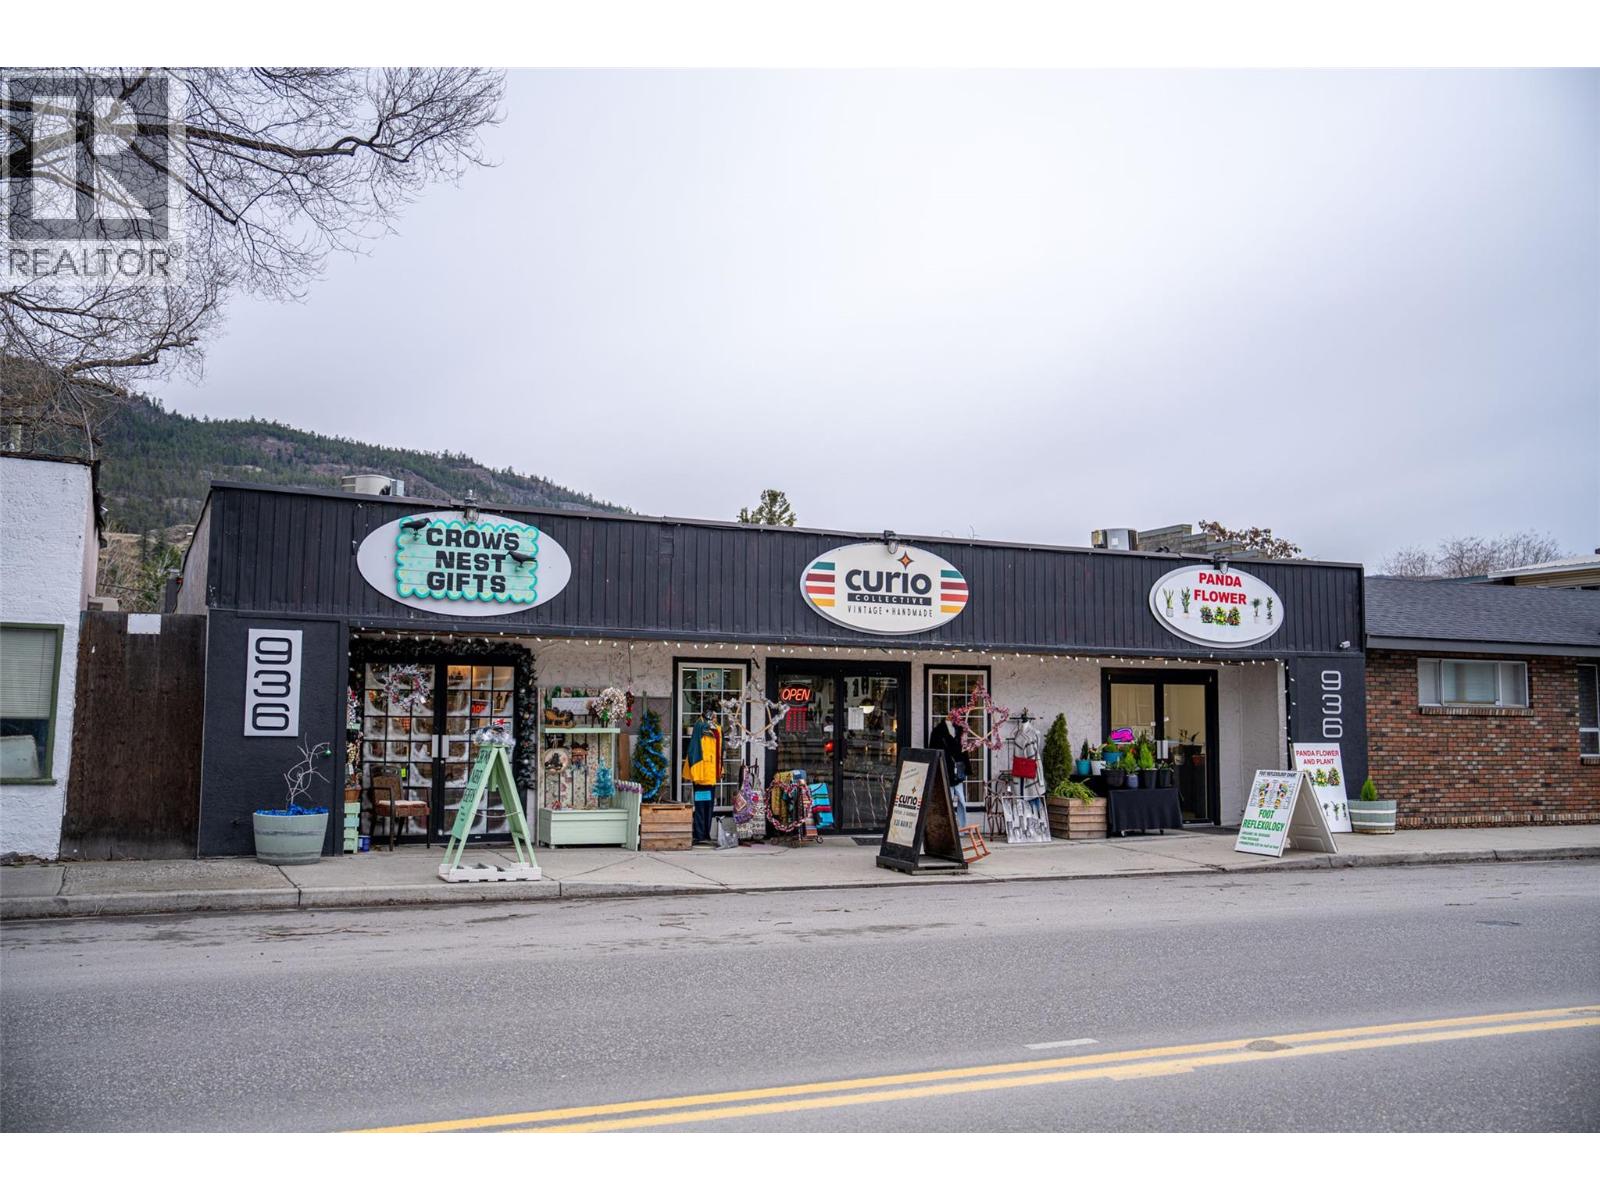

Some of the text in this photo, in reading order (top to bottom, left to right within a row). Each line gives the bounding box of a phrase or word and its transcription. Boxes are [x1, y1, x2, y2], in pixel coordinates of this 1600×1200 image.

[426, 528, 520, 550] CROW'S
[435, 551, 507, 572] NEST
[427, 571, 506, 593] GIFTS
[845, 569, 932, 595] curio
[1198, 572, 1242, 587] PANDA
[856, 594, 923, 604] COLLECTIVE
[1193, 589, 1247, 605] FLOWER
[848, 605, 933, 618] VINTAGE HANDMADE
[252, 637, 292, 731] 936
[781, 688, 811, 701] OPEN
[1321, 670, 1343, 738] 936
[1258, 809, 1275, 818] FOOT
[1243, 819, 1285, 831] REFLEXOLOGY
